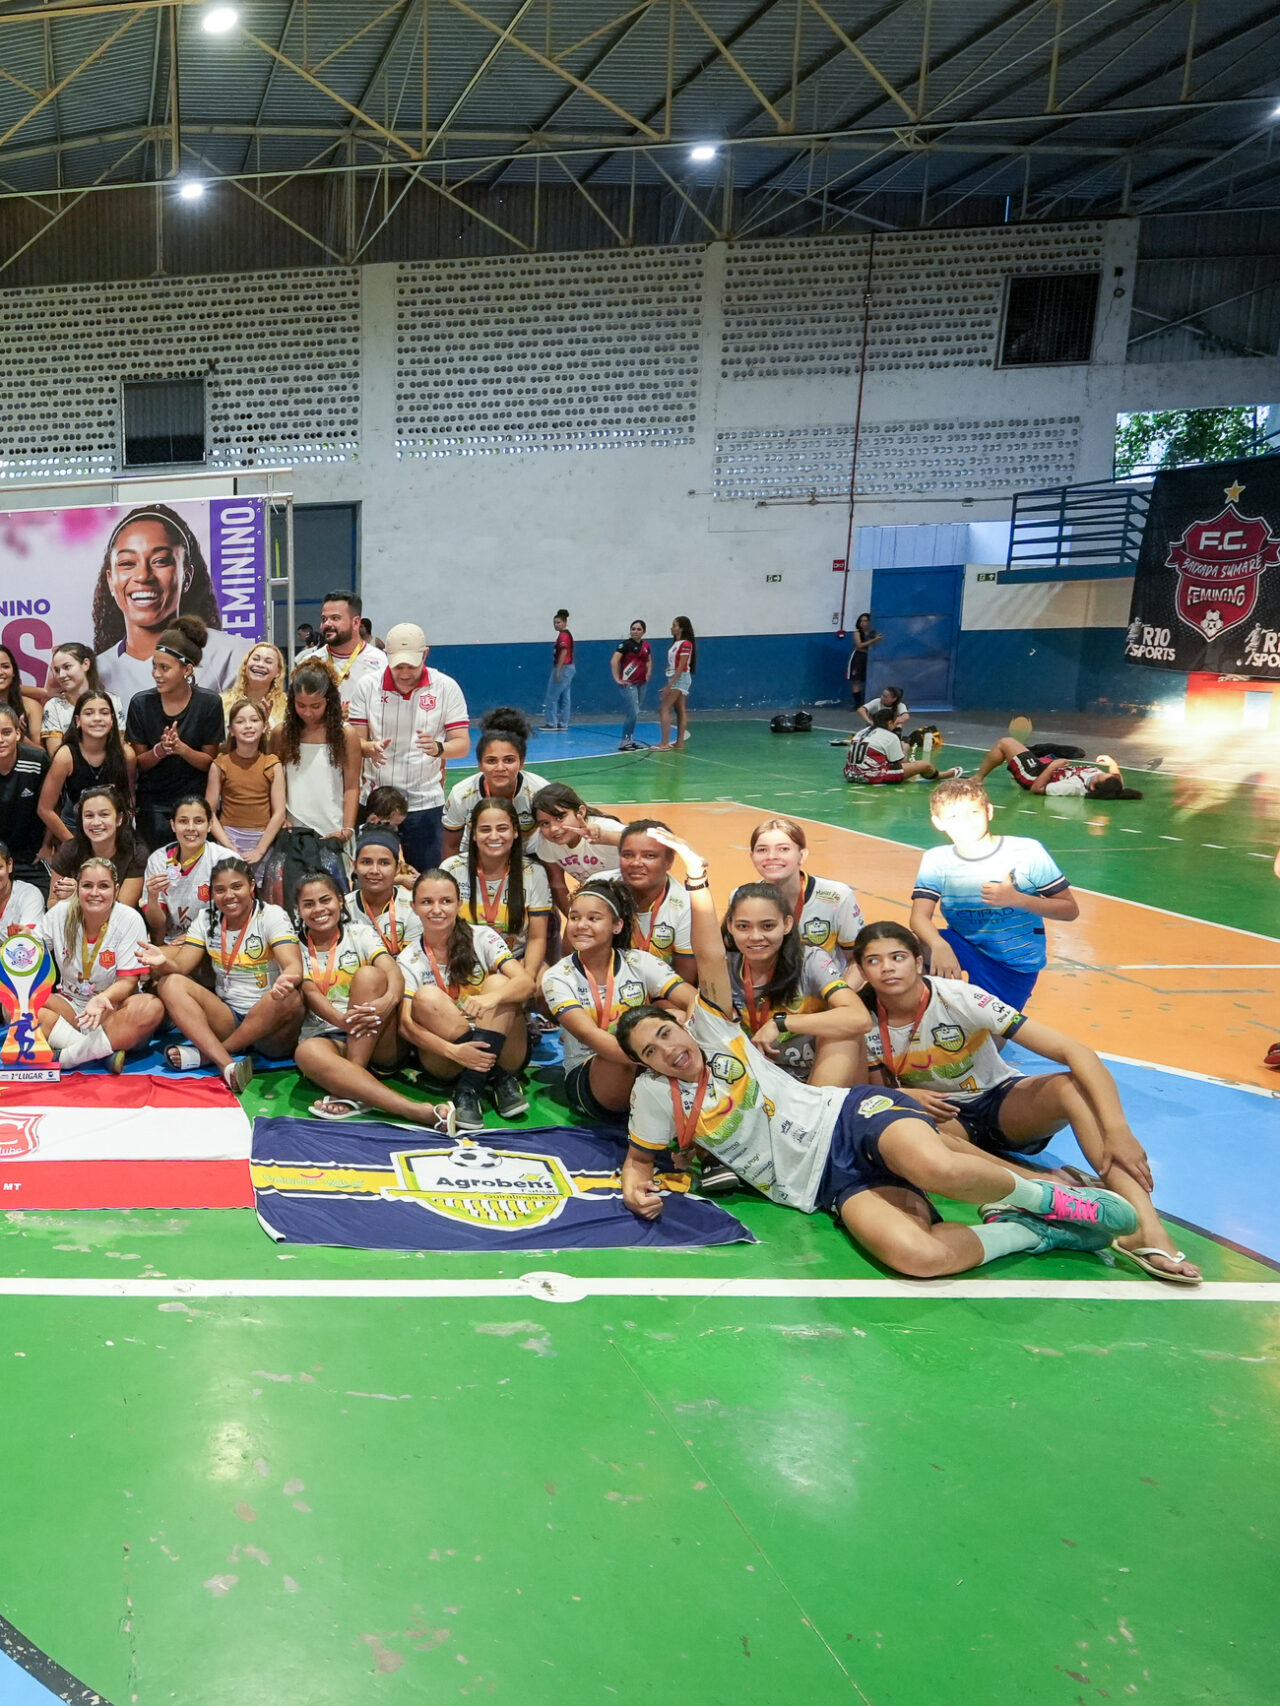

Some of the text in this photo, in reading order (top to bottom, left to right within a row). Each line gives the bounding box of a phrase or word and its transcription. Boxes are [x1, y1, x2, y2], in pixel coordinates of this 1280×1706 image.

[1199, 531, 1248, 551] F.C.
[1182, 558, 1218, 577] BAIXADA
[1187, 584, 1246, 606] FEMININO
[1143, 627, 1171, 647] R10
[1129, 644, 1176, 661] SPORTS
[19, 1072, 43, 1080] LUGAR
[959, 1075, 981, 1093] 7
[3, 1183, 22, 1191] MT
[436, 1177, 553, 1189] Agrobens
